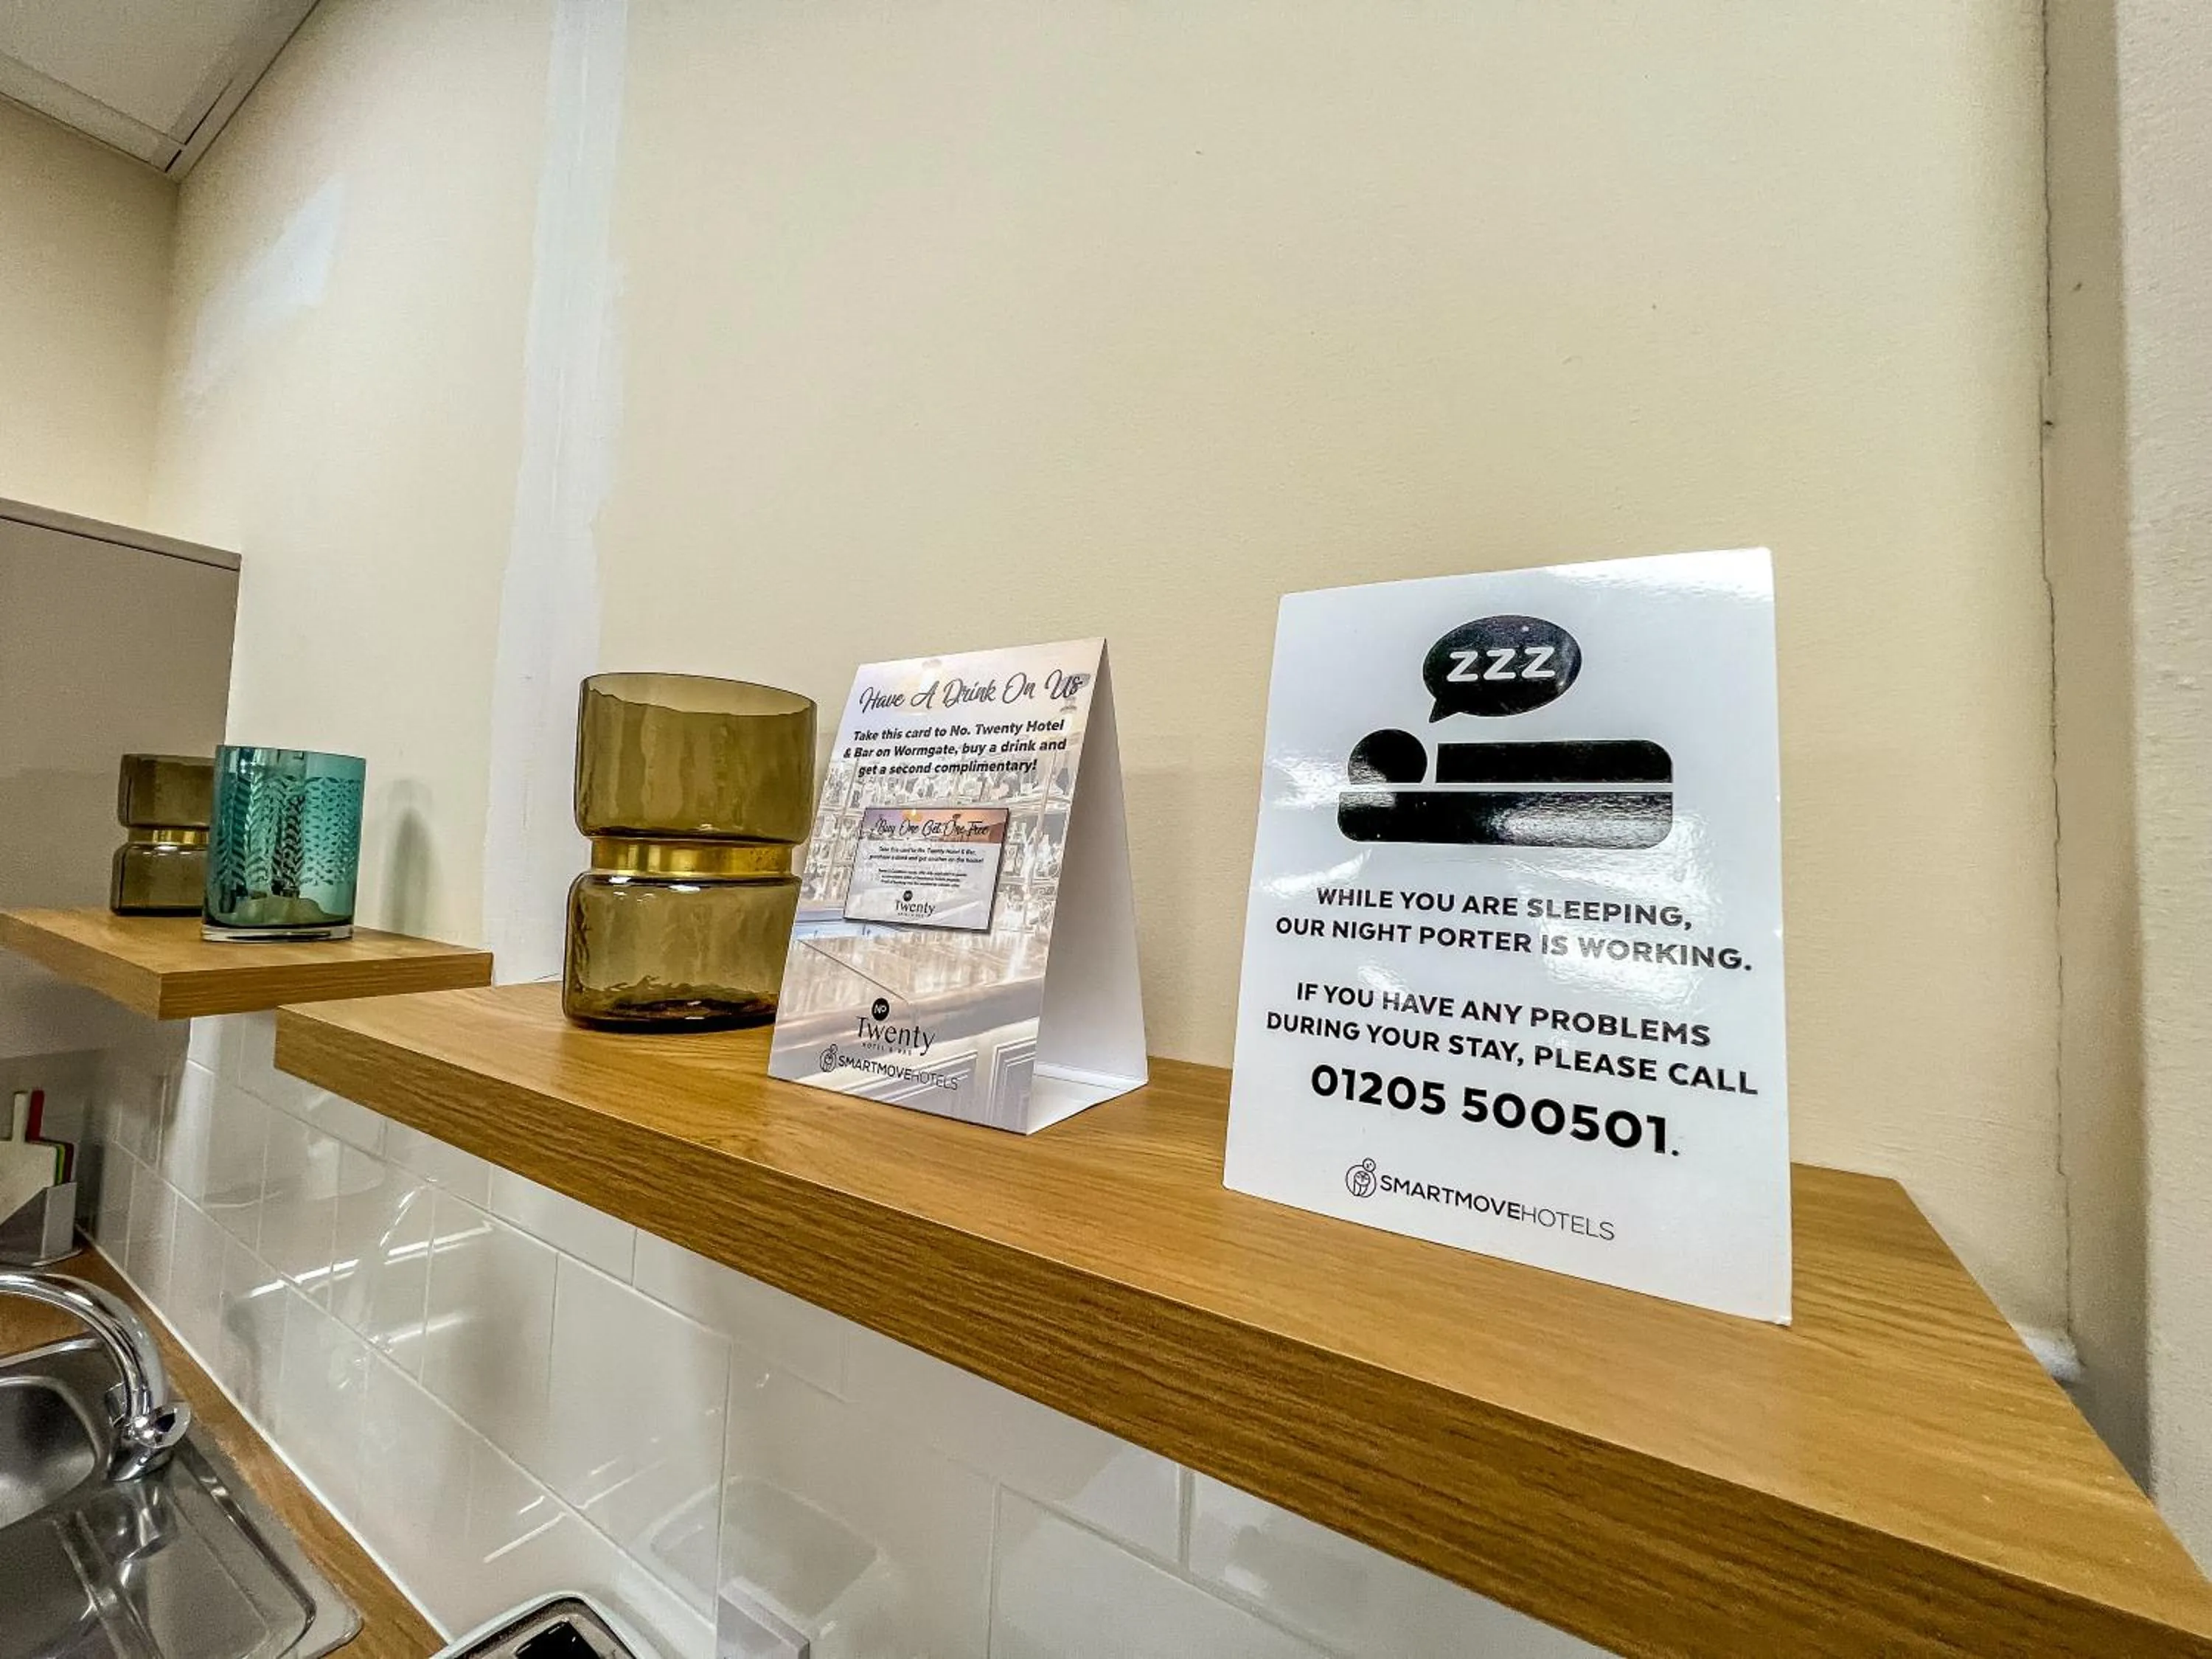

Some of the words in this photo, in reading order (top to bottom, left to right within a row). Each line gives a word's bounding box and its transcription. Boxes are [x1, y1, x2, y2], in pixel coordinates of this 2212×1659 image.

[859, 686, 905, 714] Have
[911, 681, 940, 709] A
[942, 678, 996, 708] Drink
[1002, 672, 1036, 704] On
[1044, 669, 1083, 700] Us
[843, 748, 852, 758] &
[854, 747, 874, 758] Bar
[876, 748, 891, 757] on
[894, 744, 959, 758] Wormgate,
[961, 742, 987, 756] buy
[989, 744, 997, 753] a
[1001, 739, 1036, 752] drink
[1039, 738, 1067, 751] and
[854, 729, 879, 741] Take
[881, 728, 903, 740] this
[905, 726, 933, 738] card
[934, 727, 947, 737] to
[950, 725, 971, 737] No.
[975, 722, 1023, 736] Twenty
[1026, 719, 1065, 732] Hotel
[858, 765, 878, 778] get
[880, 766, 887, 774] a
[889, 762, 933, 774] second
[934, 758, 1038, 775] complimentary!
[875, 818, 896, 835] Buy
[899, 819, 919, 835] One
[894, 900, 936, 918] Twenty
[1316, 886, 1394, 909] WHILE
[1400, 891, 1455, 913] YOU
[1461, 895, 1518, 917] ARE
[1526, 897, 1692, 931] SLEEPING,
[1276, 917, 1325, 937] OUR
[1332, 920, 1412, 943] NIGHT
[1419, 925, 1532, 953] PORTER
[1542, 933, 1568, 956] IS
[1577, 936, 1753, 972] WORKING.
[856, 1015, 936, 1057] Twenty
[1296, 982, 1318, 1001] IF
[1324, 985, 1374, 1009] YOU
[1382, 991, 1455, 1017] HAVE
[1461, 1001, 1523, 1025] ANY
[1530, 1006, 1711, 1048] PROBLEMS
[838, 1054, 959, 1091] SMARTMOVEHOTELS
[1266, 1011, 1360, 1040] DURING
[1366, 1023, 1440, 1052] YOUR
[1447, 1034, 1525, 1067] STAY,
[1534, 1044, 1658, 1082] PLEASE
[1668, 1062, 1759, 1096] CALL
[1311, 1064, 1446, 1116] 01205
[1461, 1087, 1680, 1157] 500501.
[1380, 1174, 1615, 1241] SMARTMOVEHOTELS
